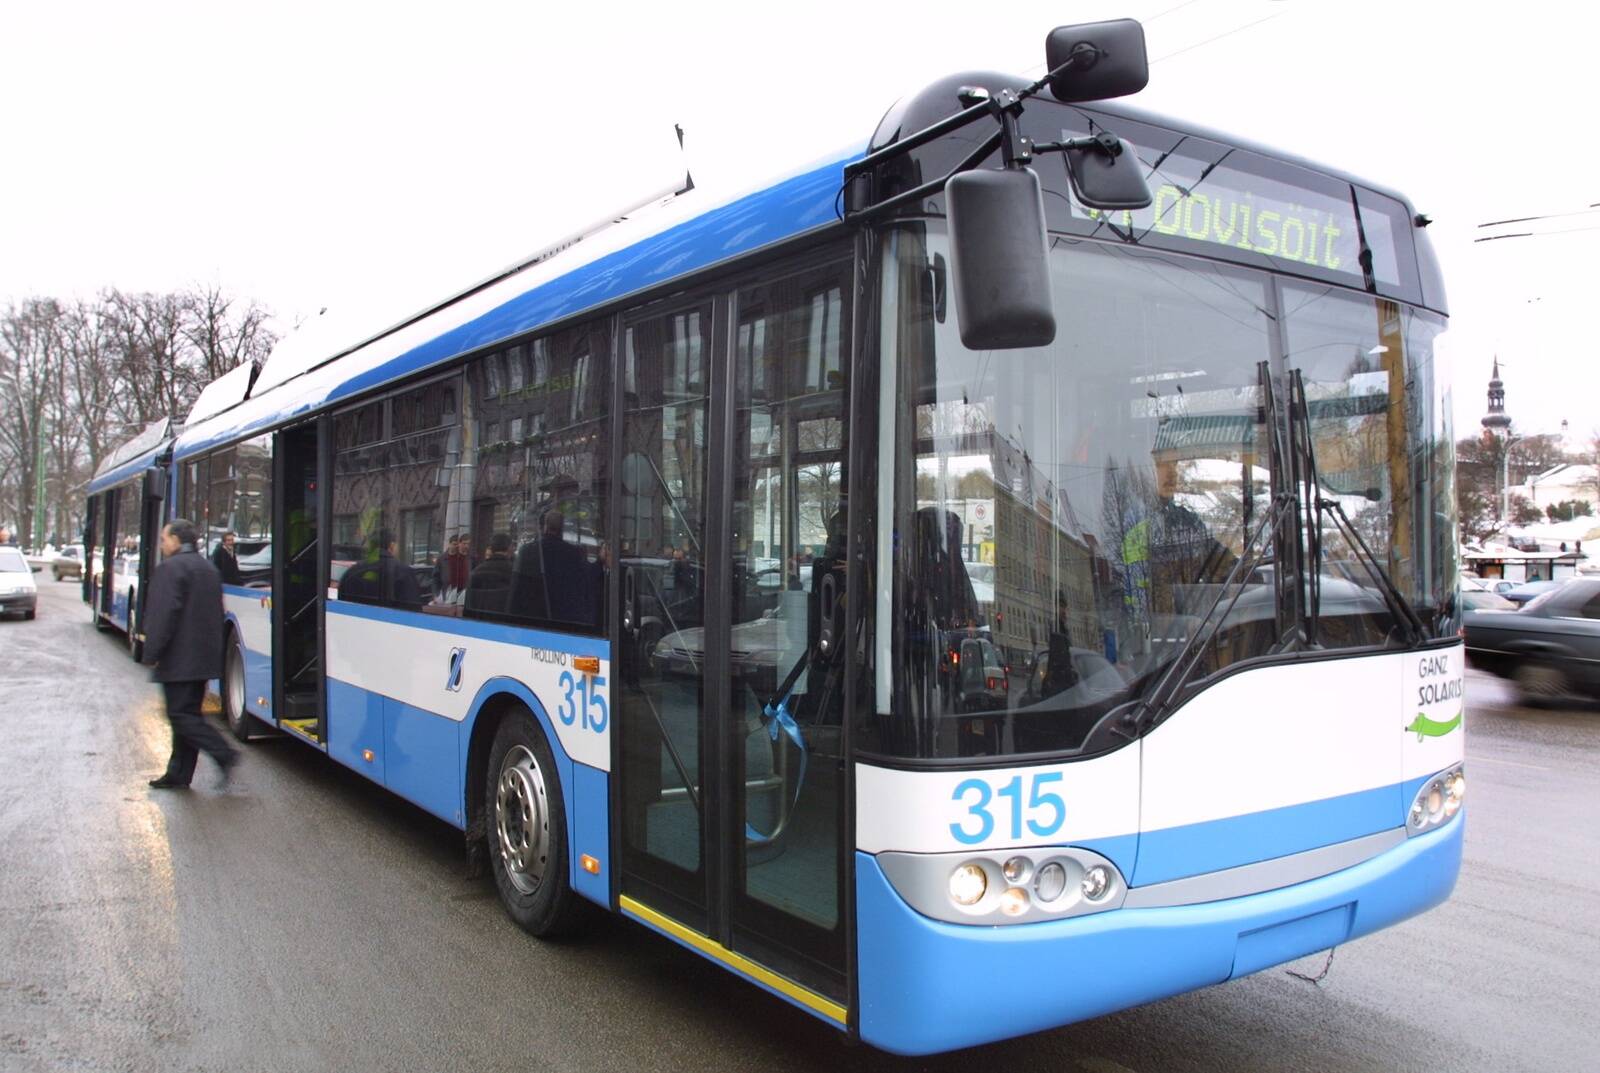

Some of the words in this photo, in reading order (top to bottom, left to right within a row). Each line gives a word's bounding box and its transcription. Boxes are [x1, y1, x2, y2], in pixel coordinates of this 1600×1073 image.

[530, 647, 567, 666] TROLLINO
[1418, 655, 1448, 678] GANZ
[558, 670, 608, 734] 315
[1418, 678, 1462, 706] SOLARIS
[949, 771, 1067, 845] 315
